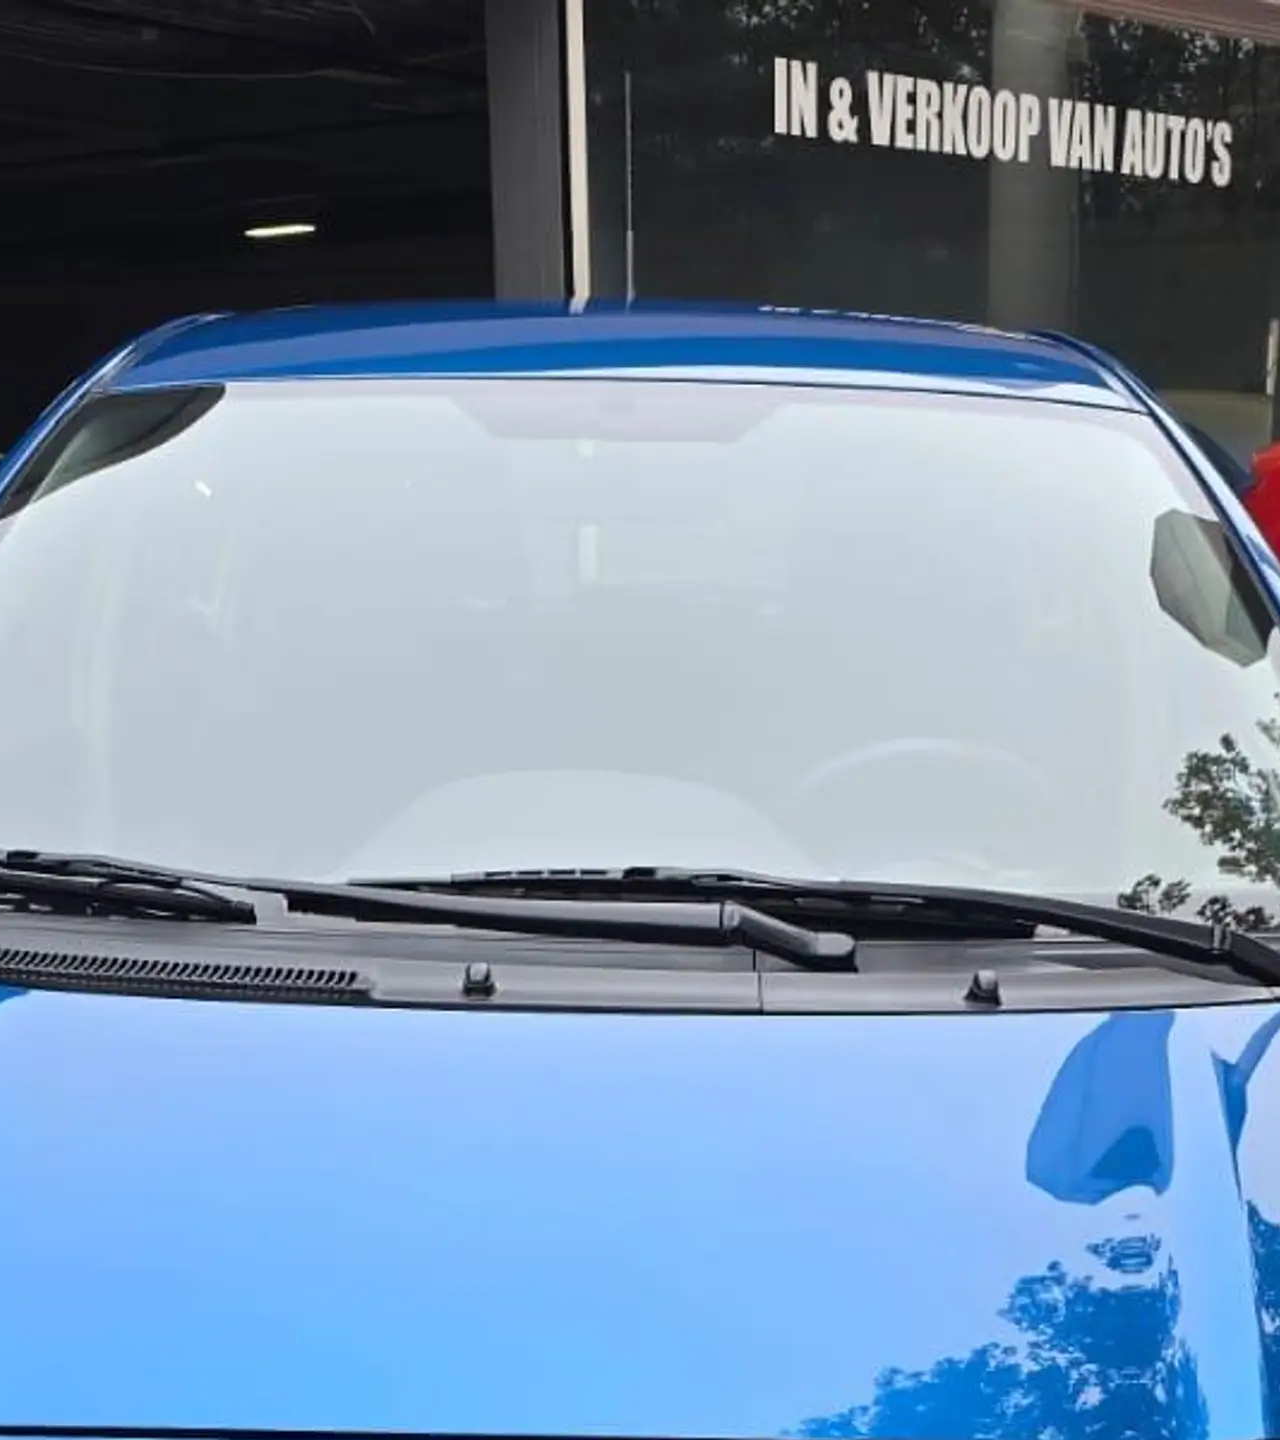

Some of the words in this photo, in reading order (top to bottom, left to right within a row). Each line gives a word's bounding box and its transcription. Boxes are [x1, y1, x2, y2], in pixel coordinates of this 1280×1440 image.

[774, 57, 817, 138] IN
[828, 77, 858, 143] &
[866, 71, 1041, 163] VERKOOP
[1049, 97, 1115, 172] VAN
[1121, 109, 1232, 187] AUTO'S
